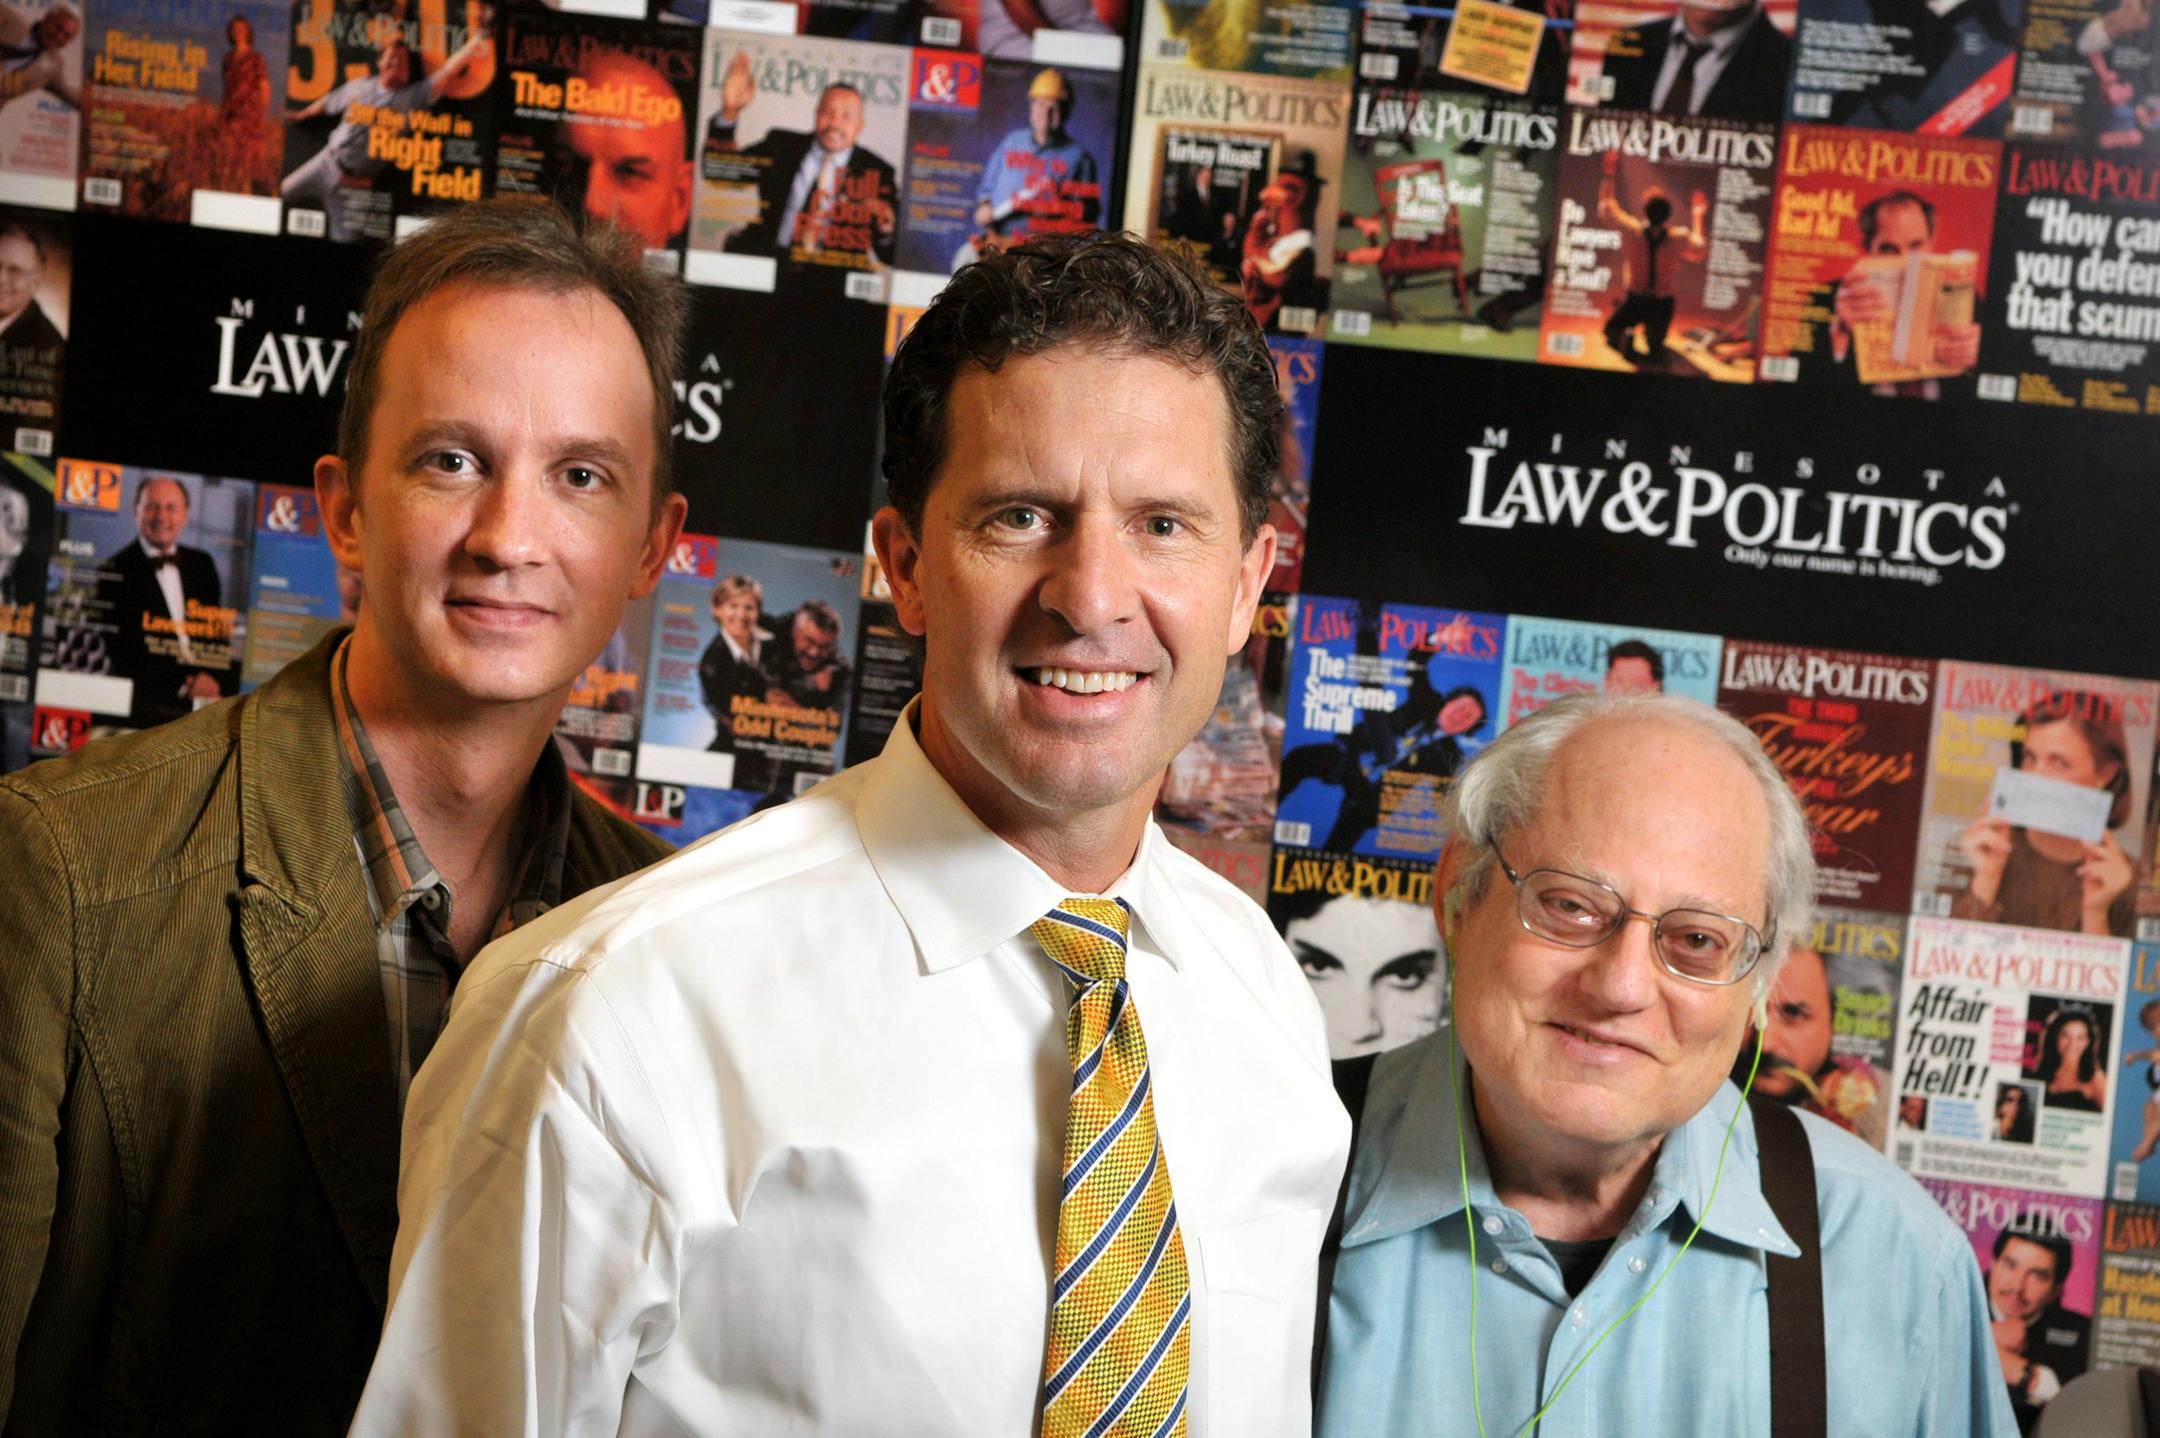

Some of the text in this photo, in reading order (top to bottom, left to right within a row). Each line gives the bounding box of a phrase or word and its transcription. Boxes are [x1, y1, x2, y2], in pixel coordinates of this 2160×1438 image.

[510, 71, 564, 109] The
[565, 78, 629, 119] Bald
[632, 85, 684, 129] Ego
[1144, 77, 1341, 128] LAW&POLITICS
[1356, 92, 1557, 149] LAW&POLITICS
[368, 127, 442, 171] Right
[1567, 111, 1775, 168] LAW&POLITICS
[1784, 132, 1995, 190] LAW&POLITICS
[411, 161, 482, 202] Field
[2015, 251, 2074, 291] you
[2006, 283, 2075, 335] that
[61, 463, 121, 506] L&P
[1483, 426, 2008, 499] MINNESOTA
[1459, 446, 2009, 570] LAW&POLITICS
[1724, 543, 1942, 587] Only our name is boring.
[1308, 647, 1346, 679] The
[1721, 647, 1930, 705] LAW&POLITICS
[1303, 698, 1354, 734] Thrill
[1304, 675, 1396, 713] Supreme
[1909, 938, 2121, 996] LAW&POLITICS
[1906, 985, 1990, 1025] Affair
[1903, 1019, 1976, 1060] from
[1901, 1058, 1990, 1099] Hell!!
